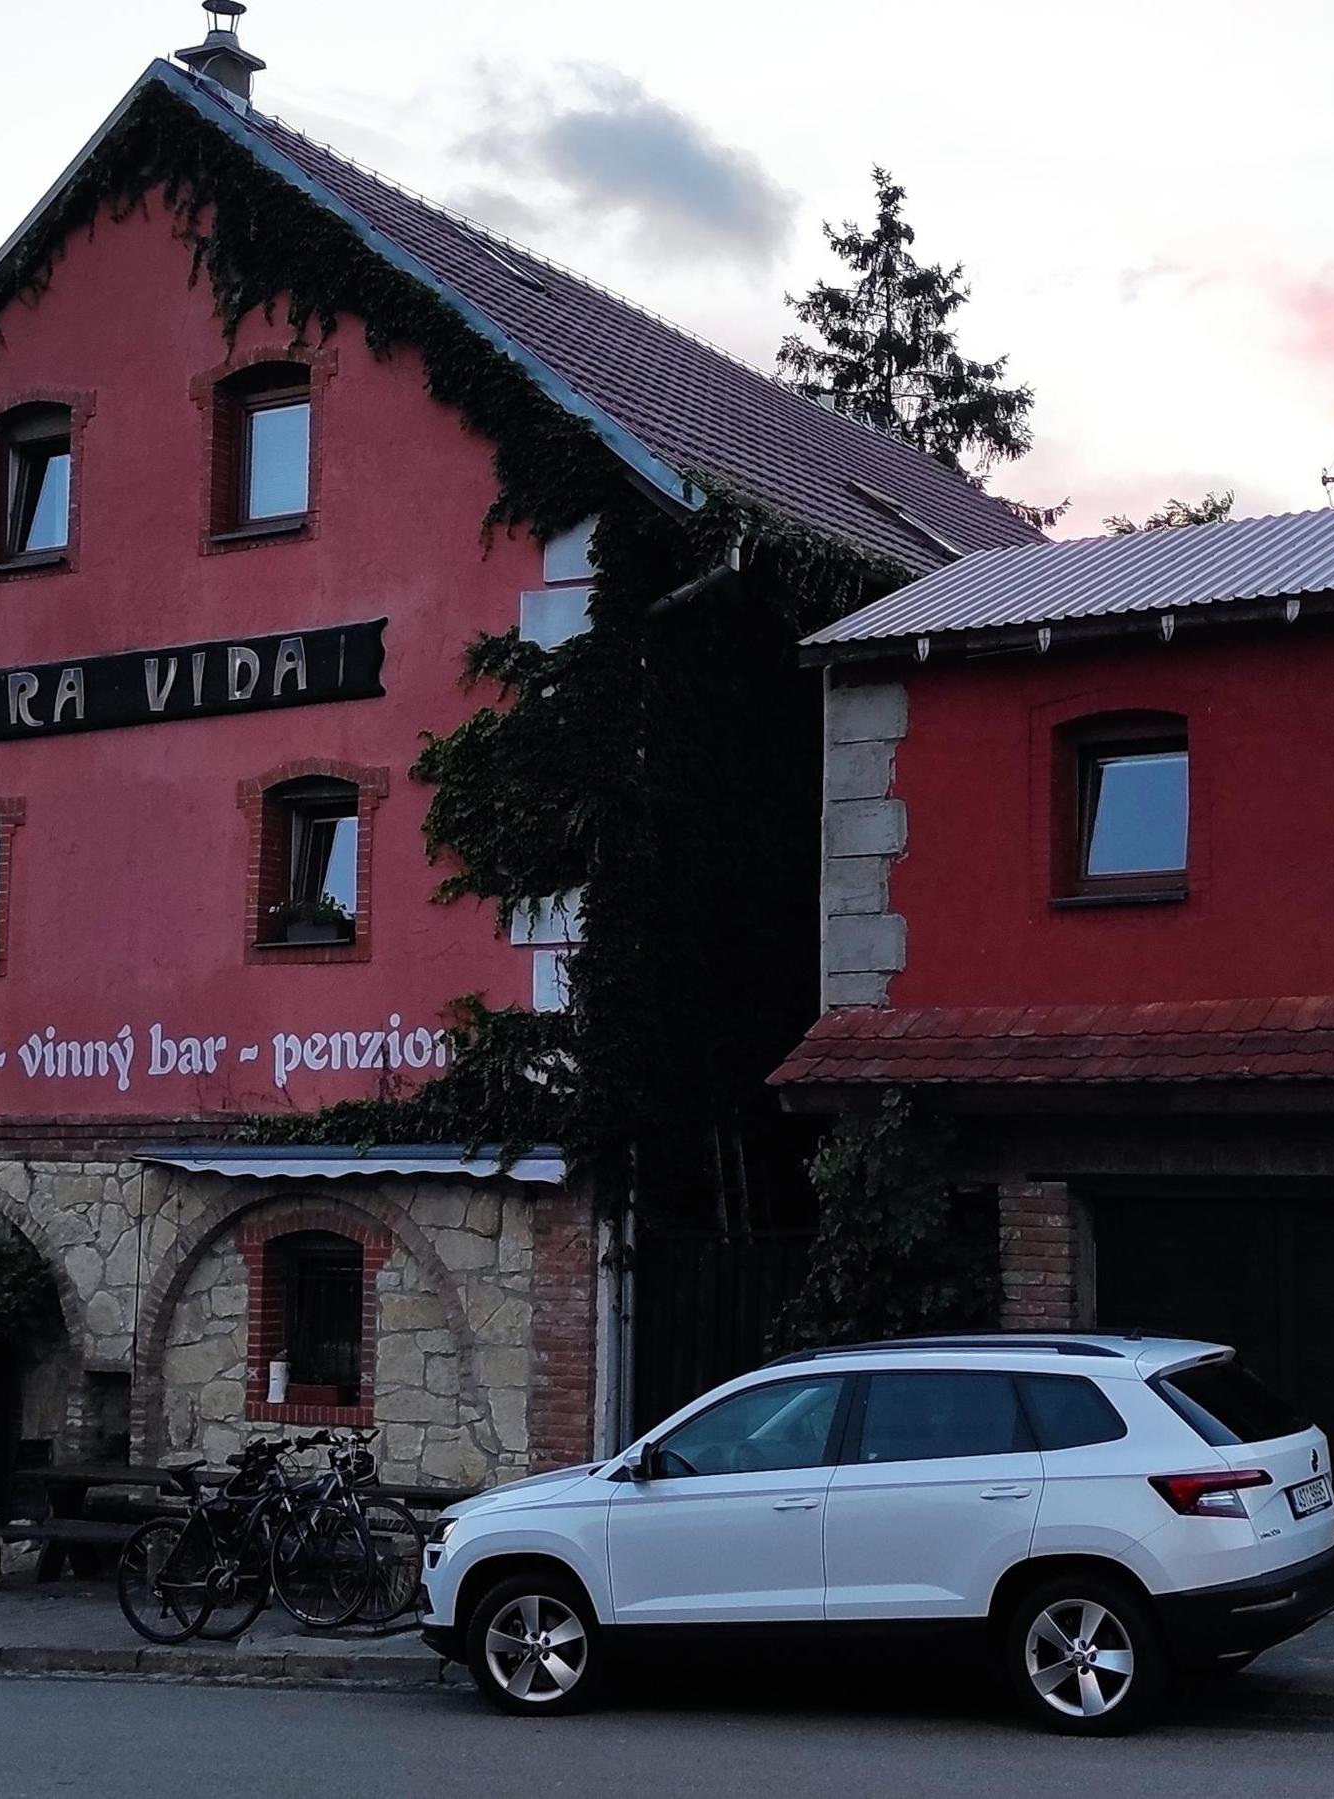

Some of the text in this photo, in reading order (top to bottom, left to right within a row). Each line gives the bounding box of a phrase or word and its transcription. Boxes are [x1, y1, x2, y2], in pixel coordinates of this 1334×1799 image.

[144, 636, 308, 712] VIDA
[17, 1023, 135, 1092] vinný
[148, 1023, 227, 1075] bar
